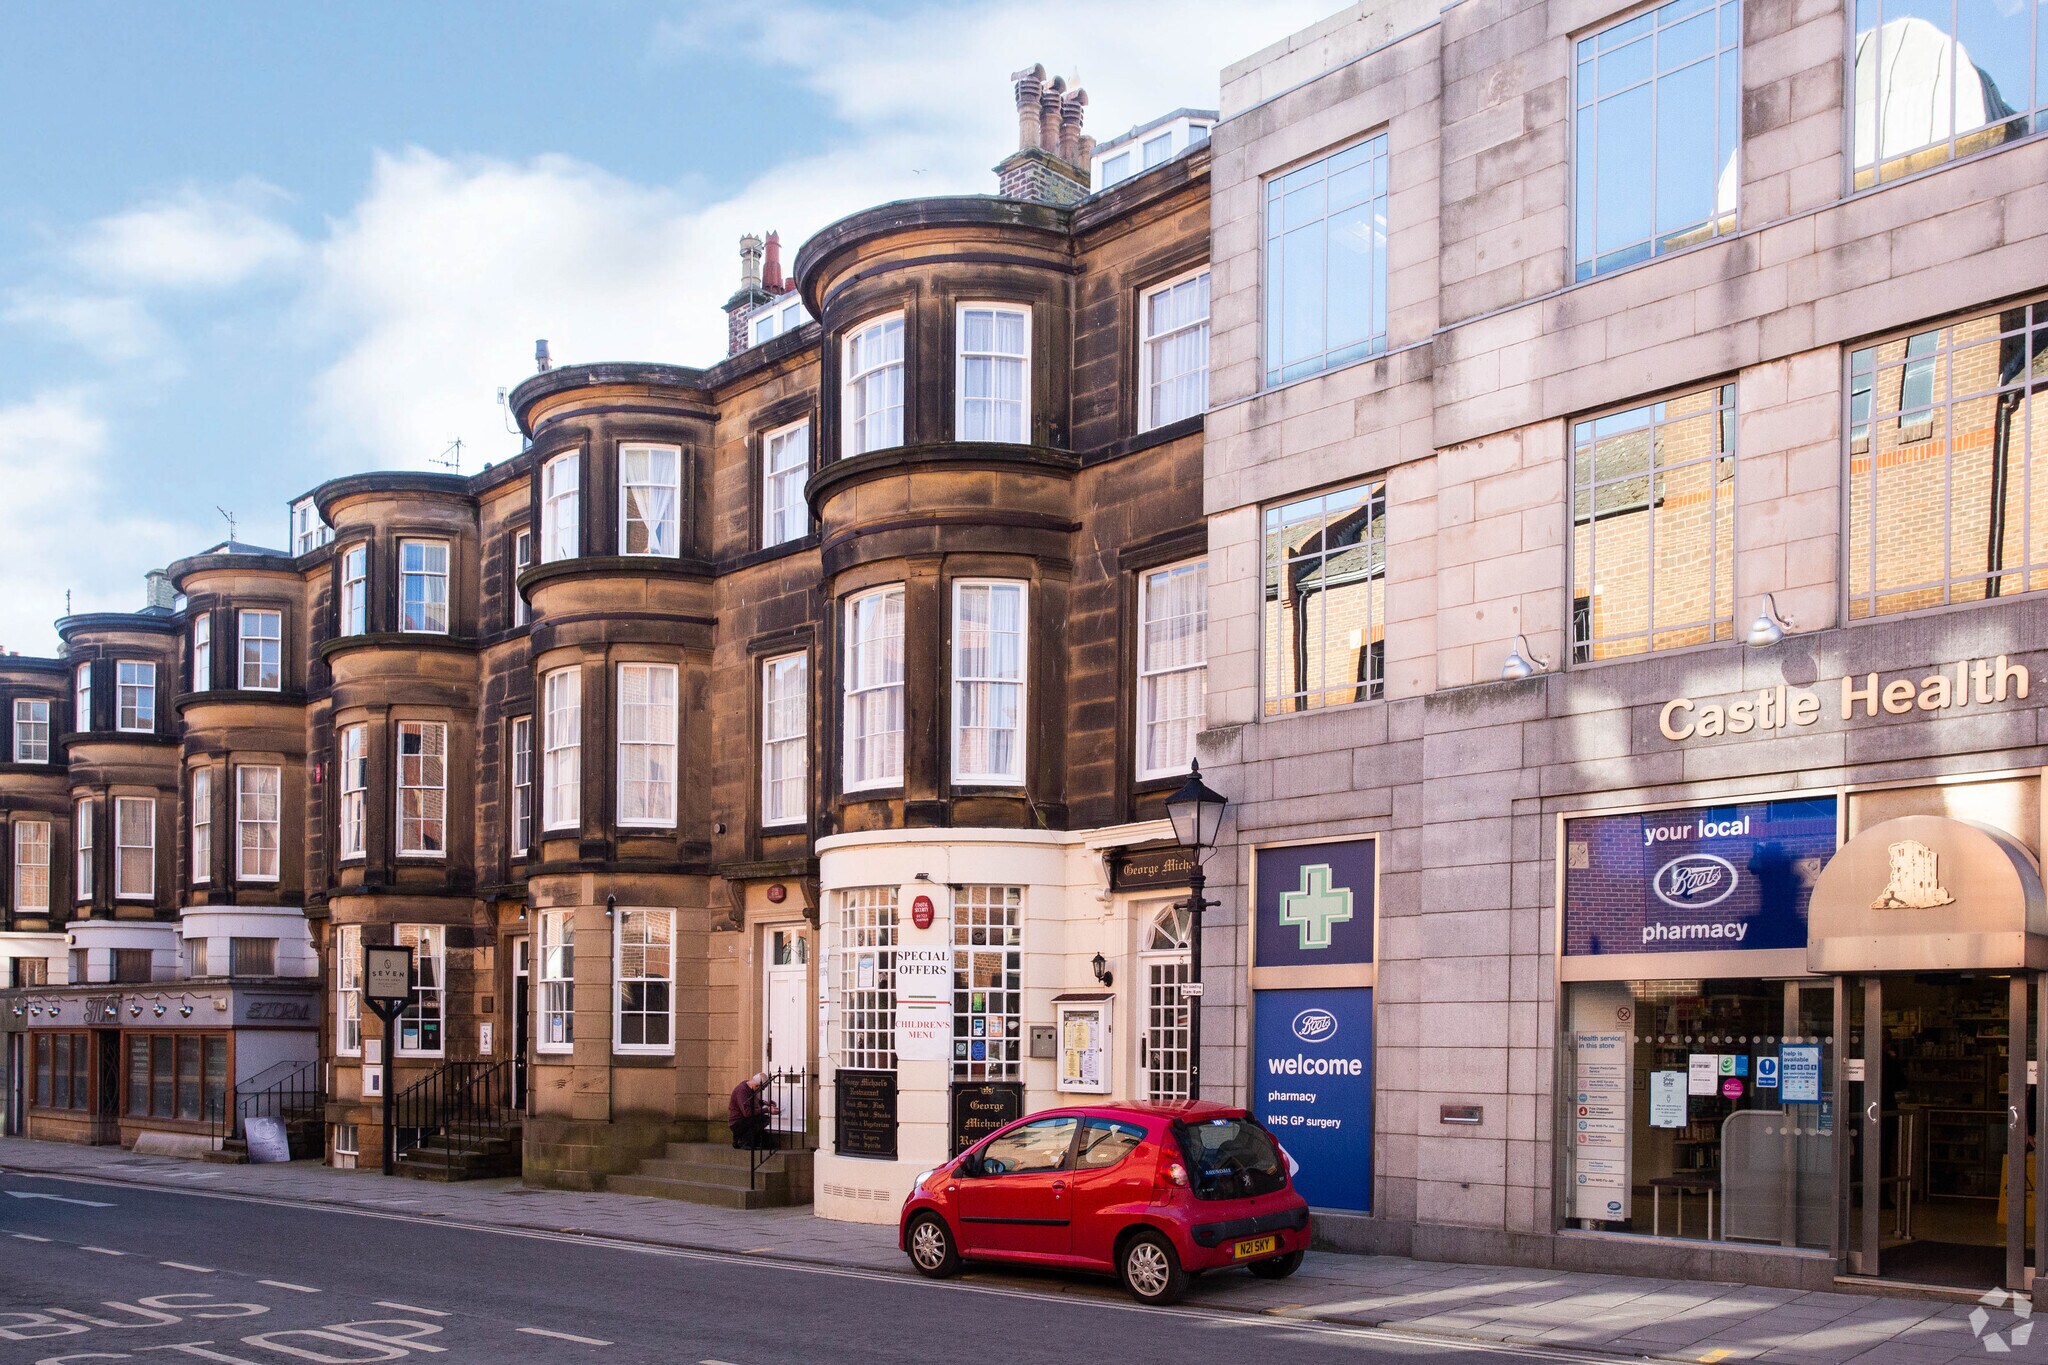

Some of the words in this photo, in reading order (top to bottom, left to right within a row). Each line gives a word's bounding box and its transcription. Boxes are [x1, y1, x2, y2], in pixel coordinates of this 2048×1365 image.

[1659, 684, 1821, 741] Castle
[1840, 654, 2030, 721] Health
[1645, 824, 1692, 846] your
[1698, 815, 1750, 838] local
[1123, 862, 1159, 877] George
[1666, 865, 1722, 896] Boots
[1642, 922, 1748, 944] pharmacy
[897, 951, 949, 962] SPECIAL
[1179, 956, 1185, 965] 5
[899, 965, 947, 975] OFFERS
[246, 1002, 309, 1019] STORM
[895, 1021, 950, 1029] CHILDREN'S
[1299, 1015, 1331, 1035] Boots
[1192, 1066, 1198, 1075] 2
[1268, 1053, 1362, 1076] welcome
[1268, 1090, 1316, 1104] pharmacy
[970, 1100, 1005, 1114] George
[1268, 1115, 1288, 1125] NHS
[1290, 1116, 1304, 1126] GP
[1306, 1118, 1341, 1129] surgery
[1240, 1244, 1254, 1256] N21
[1254, 1239, 1270, 1252] SKY
[0, 1293, 270, 1340] BUS
